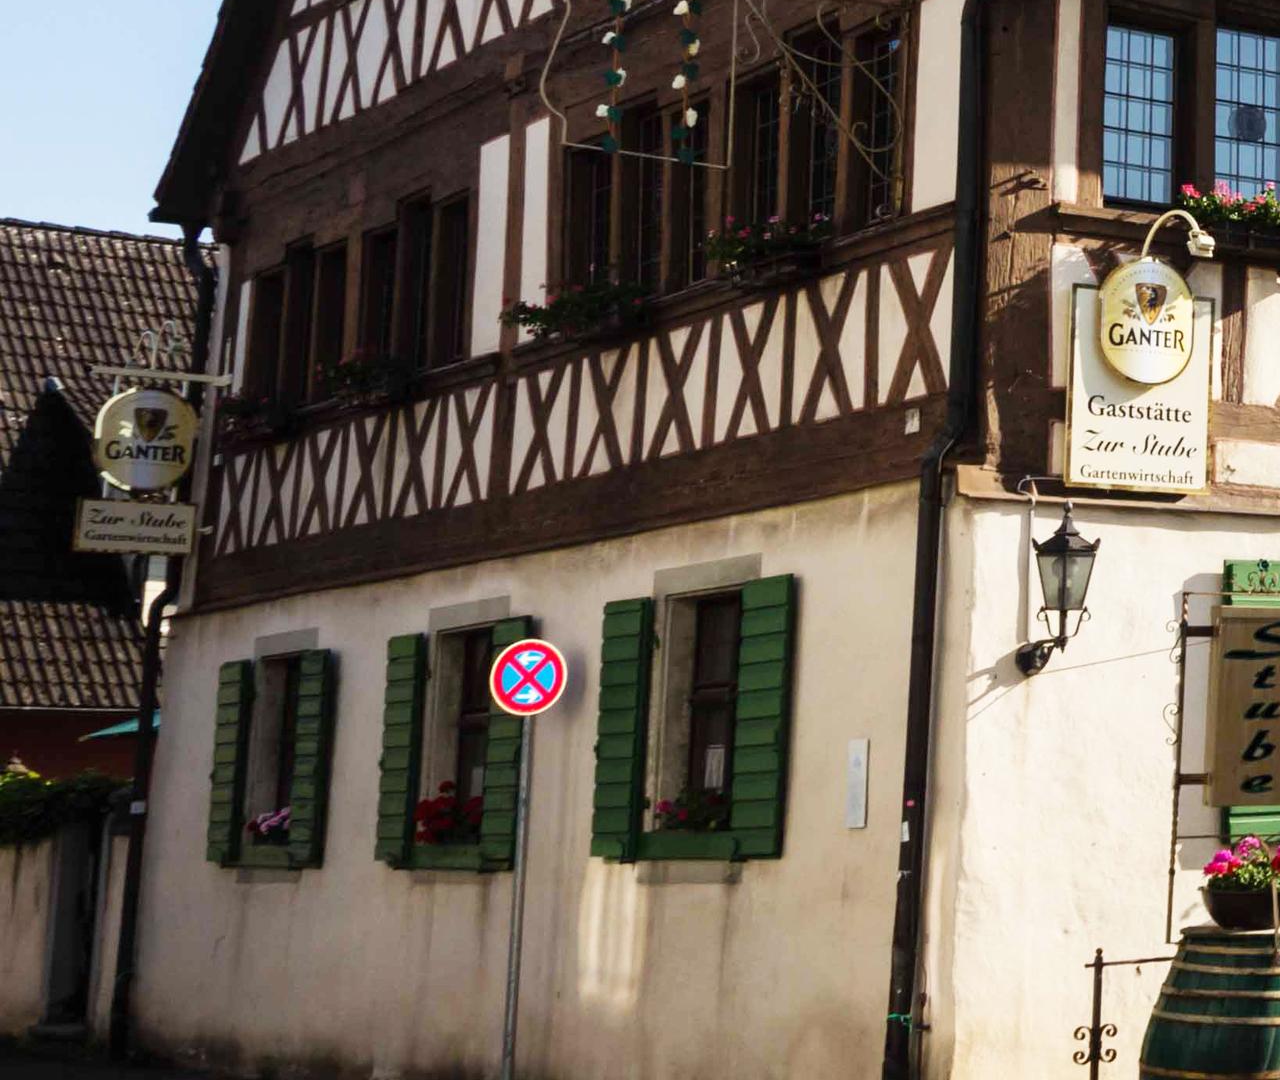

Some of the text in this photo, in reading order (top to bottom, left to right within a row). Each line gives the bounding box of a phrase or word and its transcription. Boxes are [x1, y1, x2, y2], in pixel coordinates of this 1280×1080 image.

[1108, 322, 1185, 353] GANTER
[1087, 394, 1193, 424] Gaststätte
[105, 440, 185, 465] GANTER
[1080, 429, 1198, 460] Zur Stube
[1080, 463, 1194, 486] Gartenwirtschaft
[87, 507, 187, 530] Zur Stube
